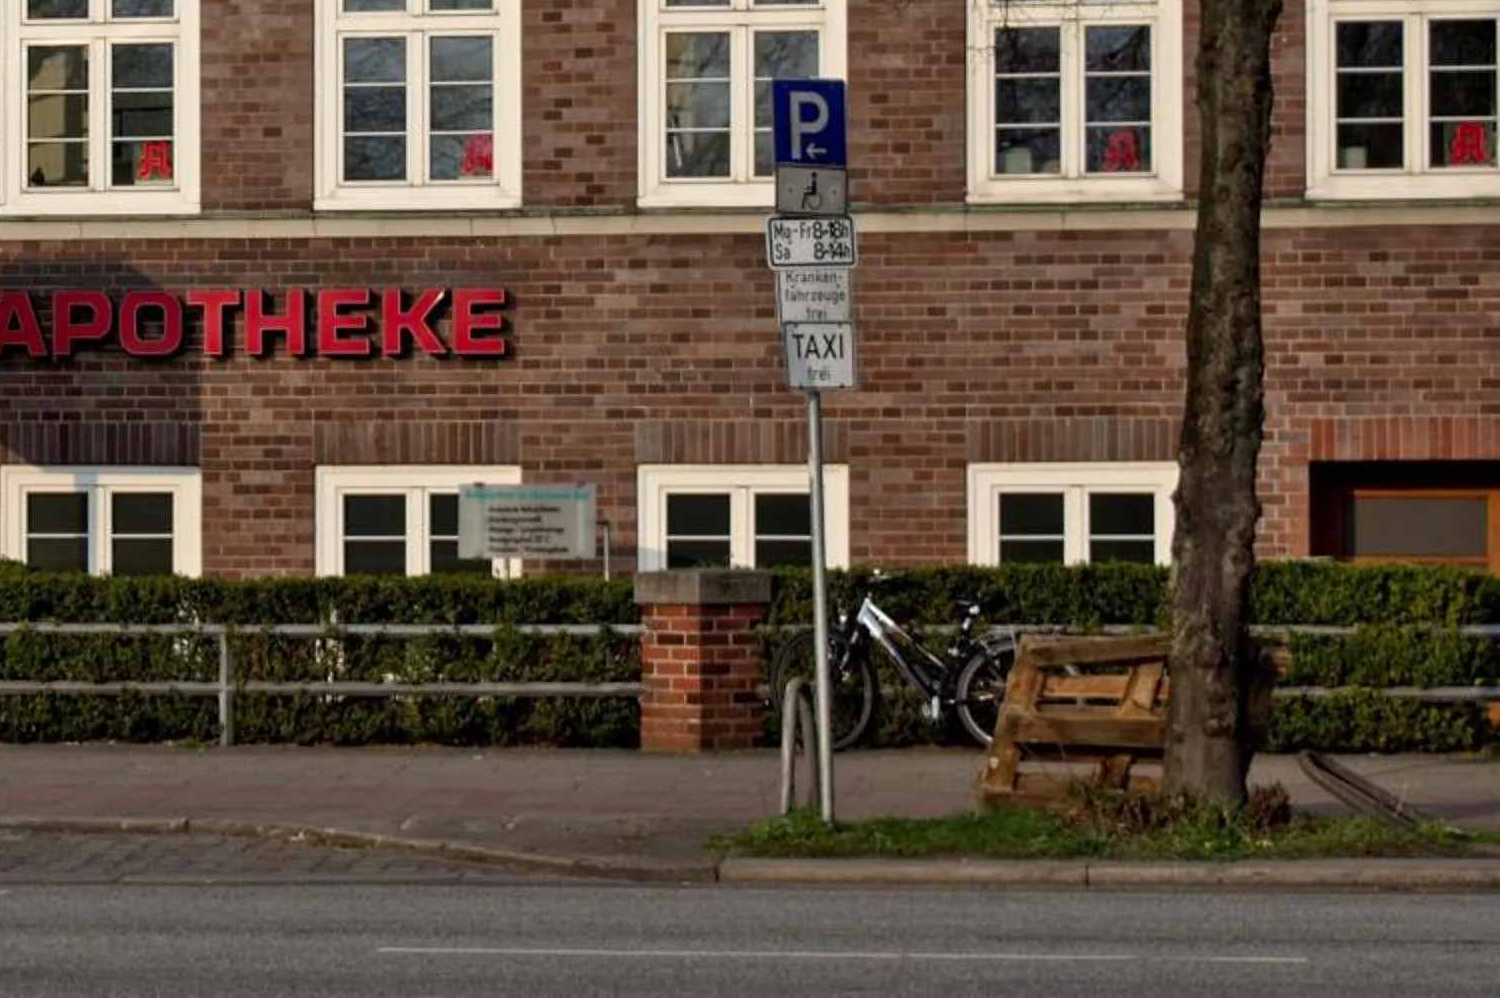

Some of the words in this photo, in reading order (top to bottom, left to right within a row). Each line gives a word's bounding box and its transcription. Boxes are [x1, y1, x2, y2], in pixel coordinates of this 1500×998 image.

[789, 90, 830, 160] P
[775, 243, 791, 260] Sa
[792, 333, 844, 360] TAXI
